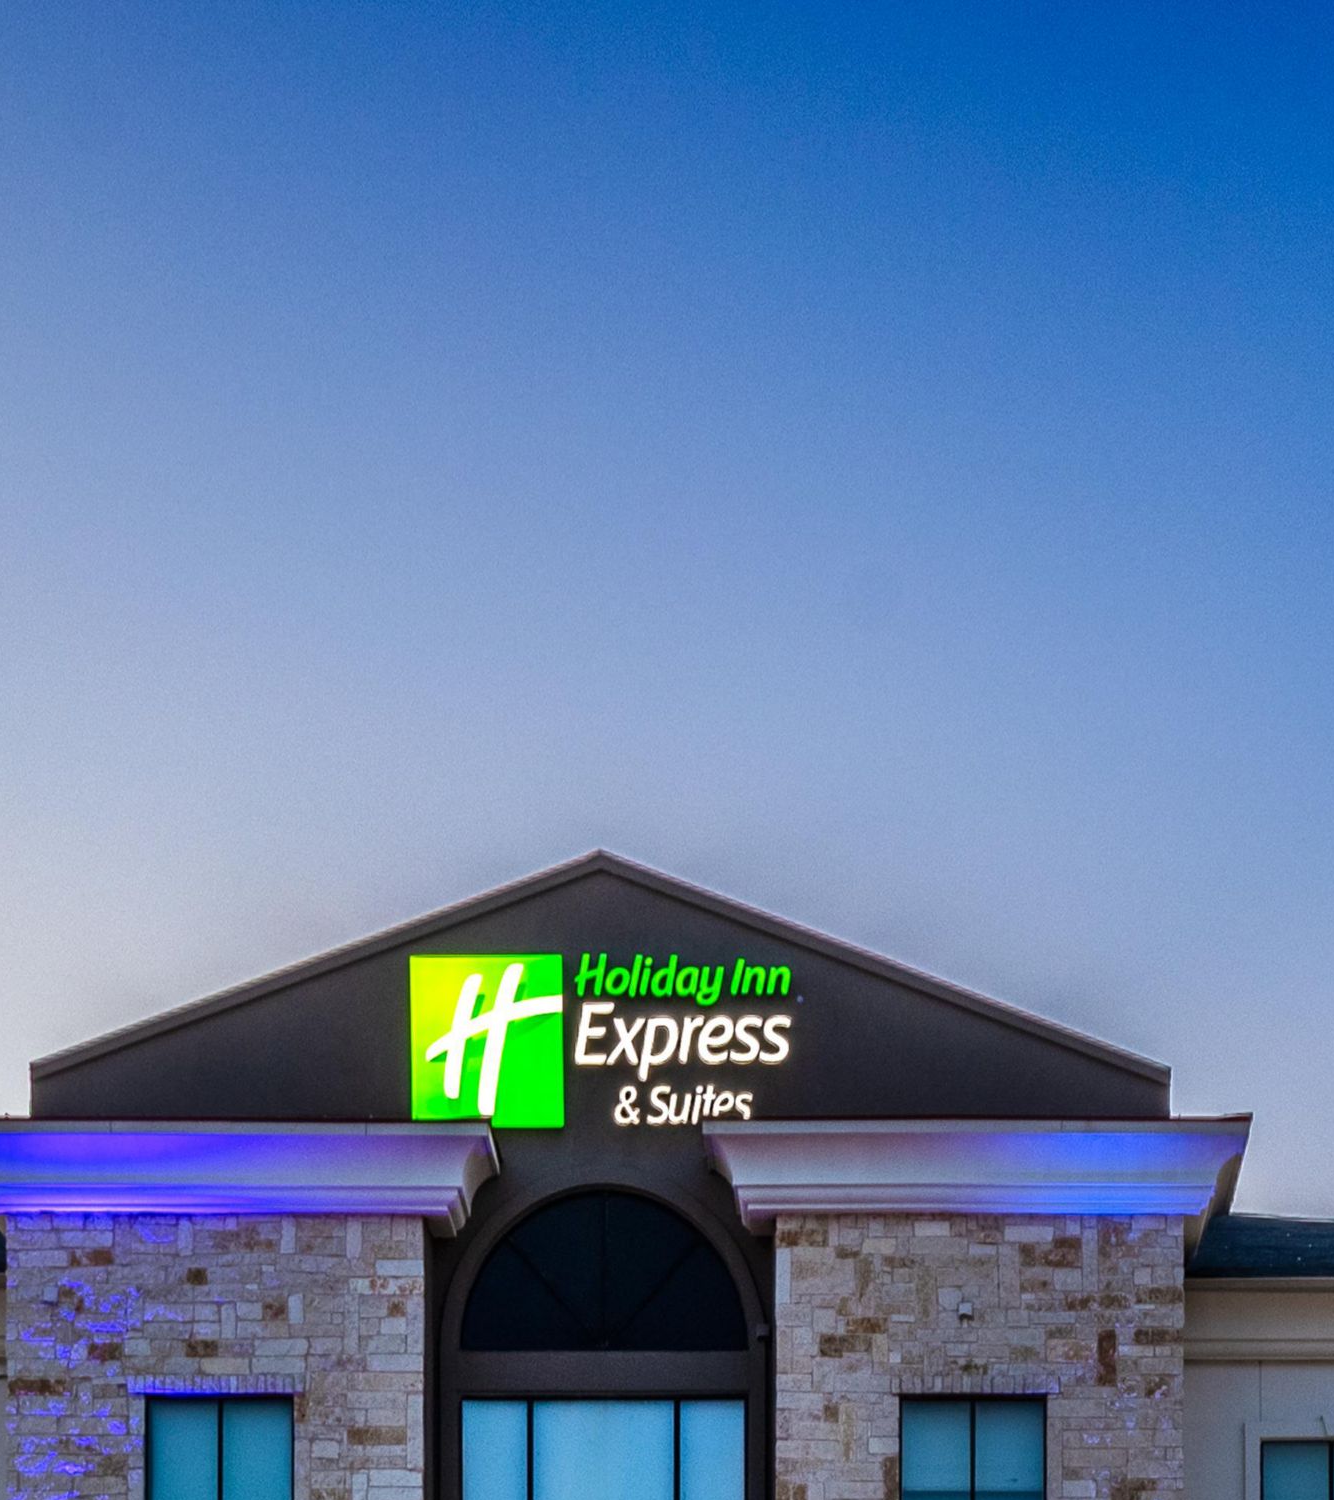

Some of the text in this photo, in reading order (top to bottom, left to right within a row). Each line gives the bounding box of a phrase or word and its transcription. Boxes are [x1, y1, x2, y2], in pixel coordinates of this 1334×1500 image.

[574, 953, 792, 1006] Holiday Inn
[574, 1001, 793, 1082] Express
[614, 1084, 754, 1126] & Suites
